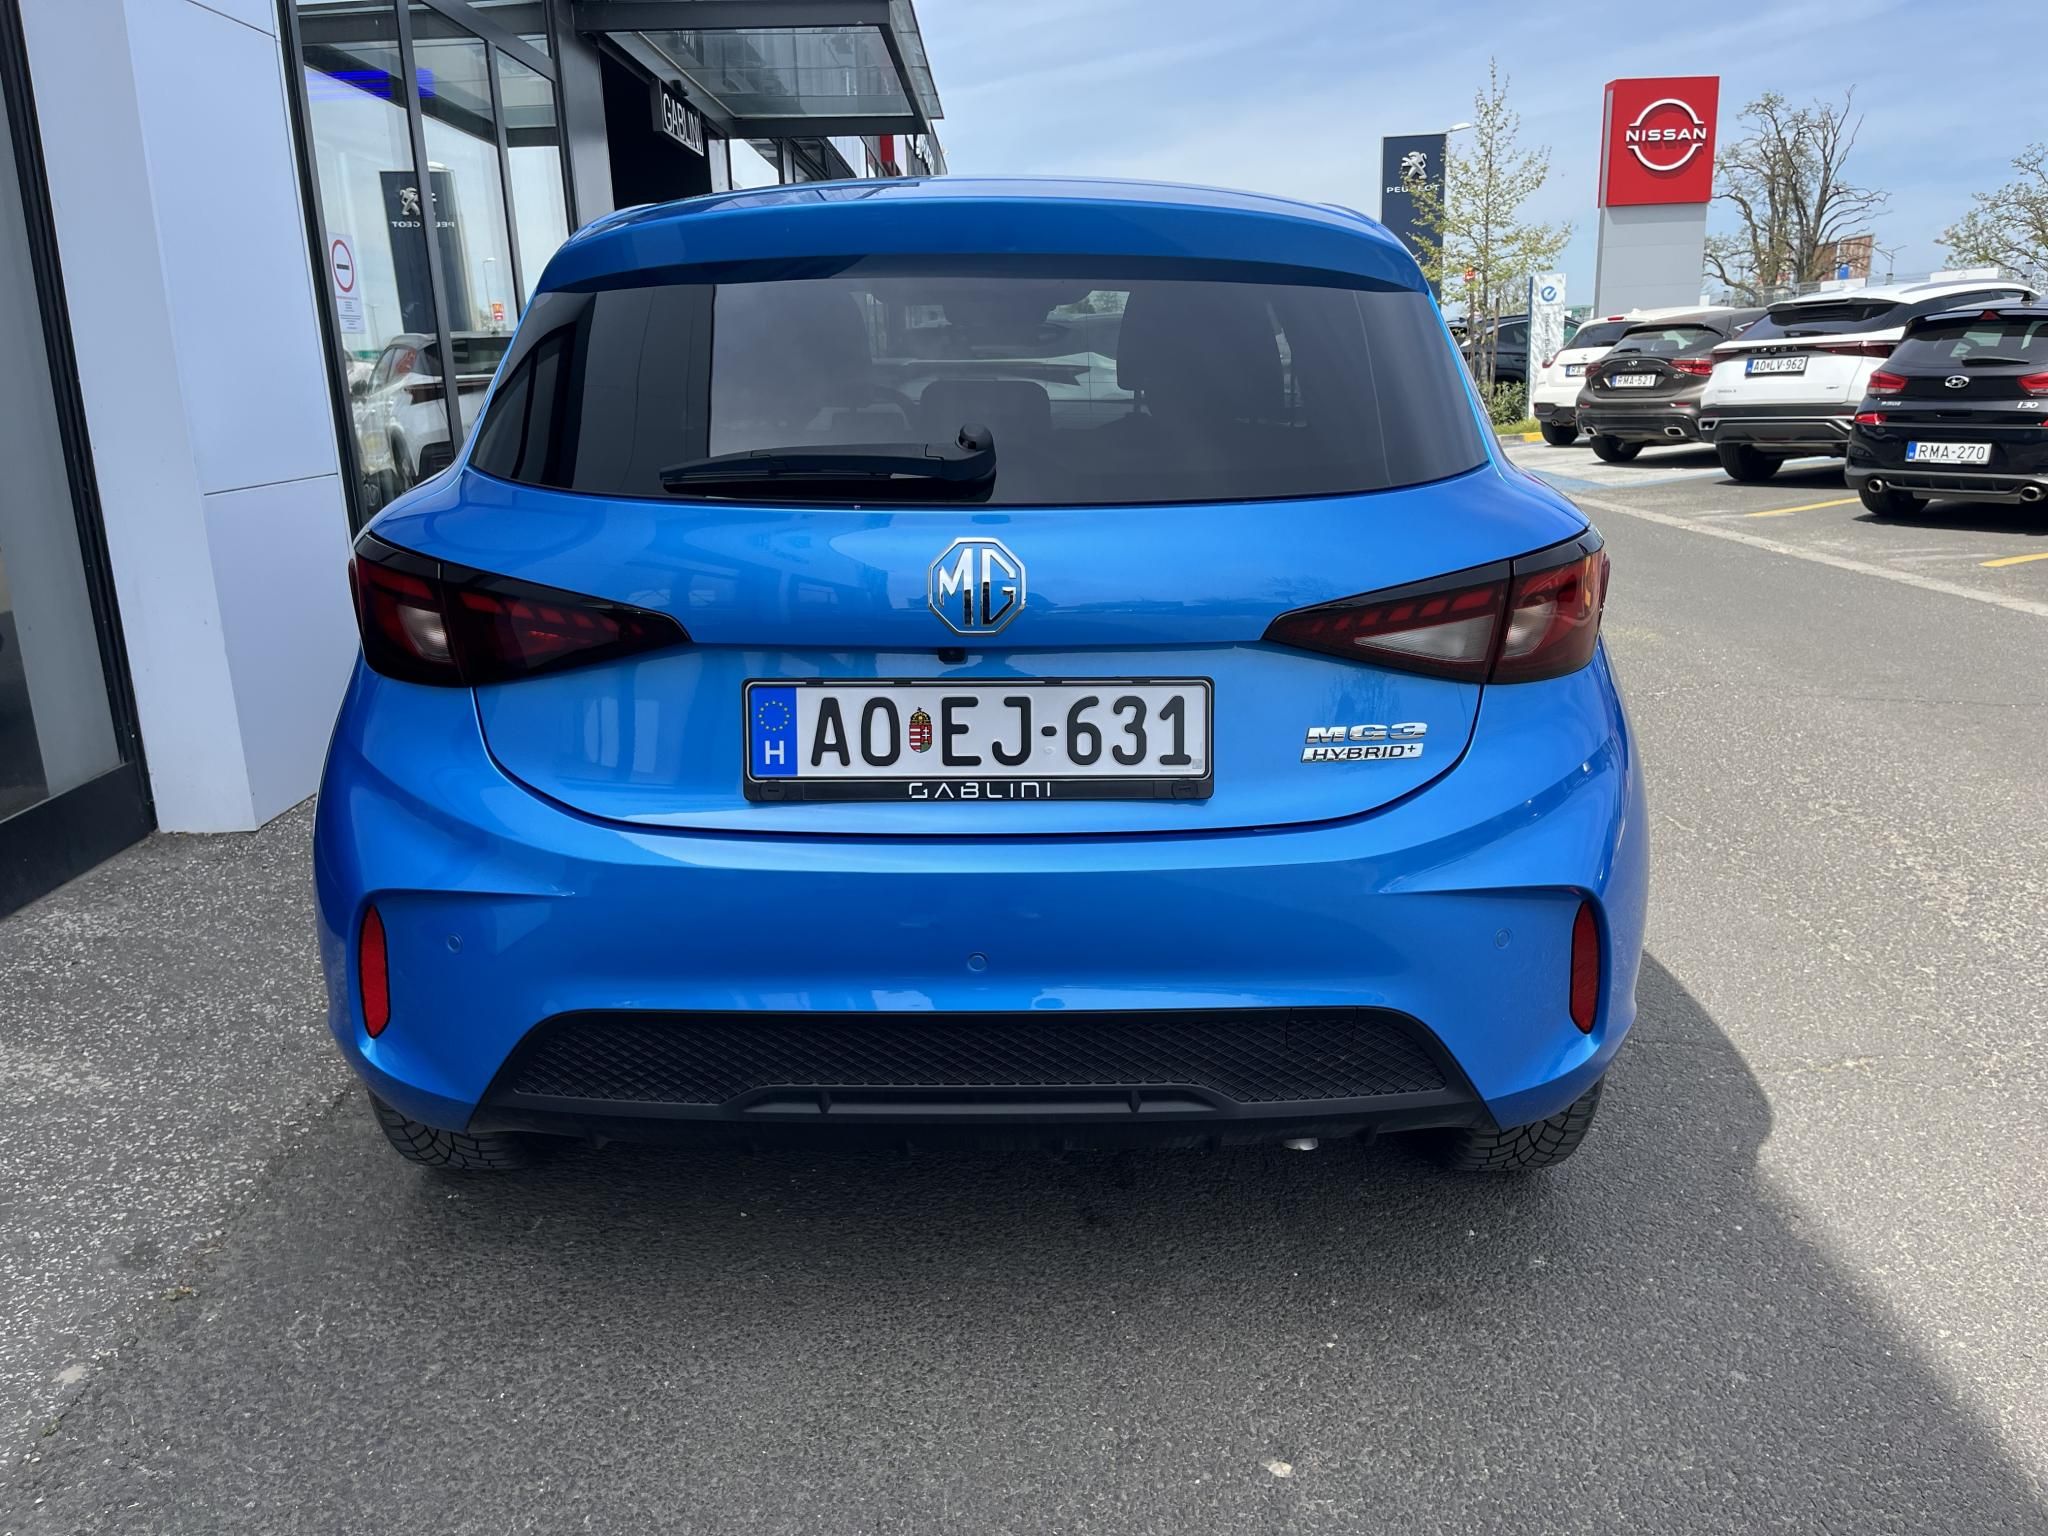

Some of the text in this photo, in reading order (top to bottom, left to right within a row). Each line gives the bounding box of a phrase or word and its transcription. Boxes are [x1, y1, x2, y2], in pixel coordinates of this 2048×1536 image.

[663, 93, 704, 153] GABLINI
[1625, 127, 1706, 142] NISSAN
[1386, 184, 1440, 193] PEUEOT
[1617, 374, 1654, 386] RMA-521
[1918, 444, 1986, 460] RMA-270
[939, 547, 1017, 626] MG
[1306, 722, 1428, 744] MG3
[764, 740, 785, 765] H
[1312, 744, 1416, 761] HYBRID+
[908, 782, 1051, 799] GABLINI
